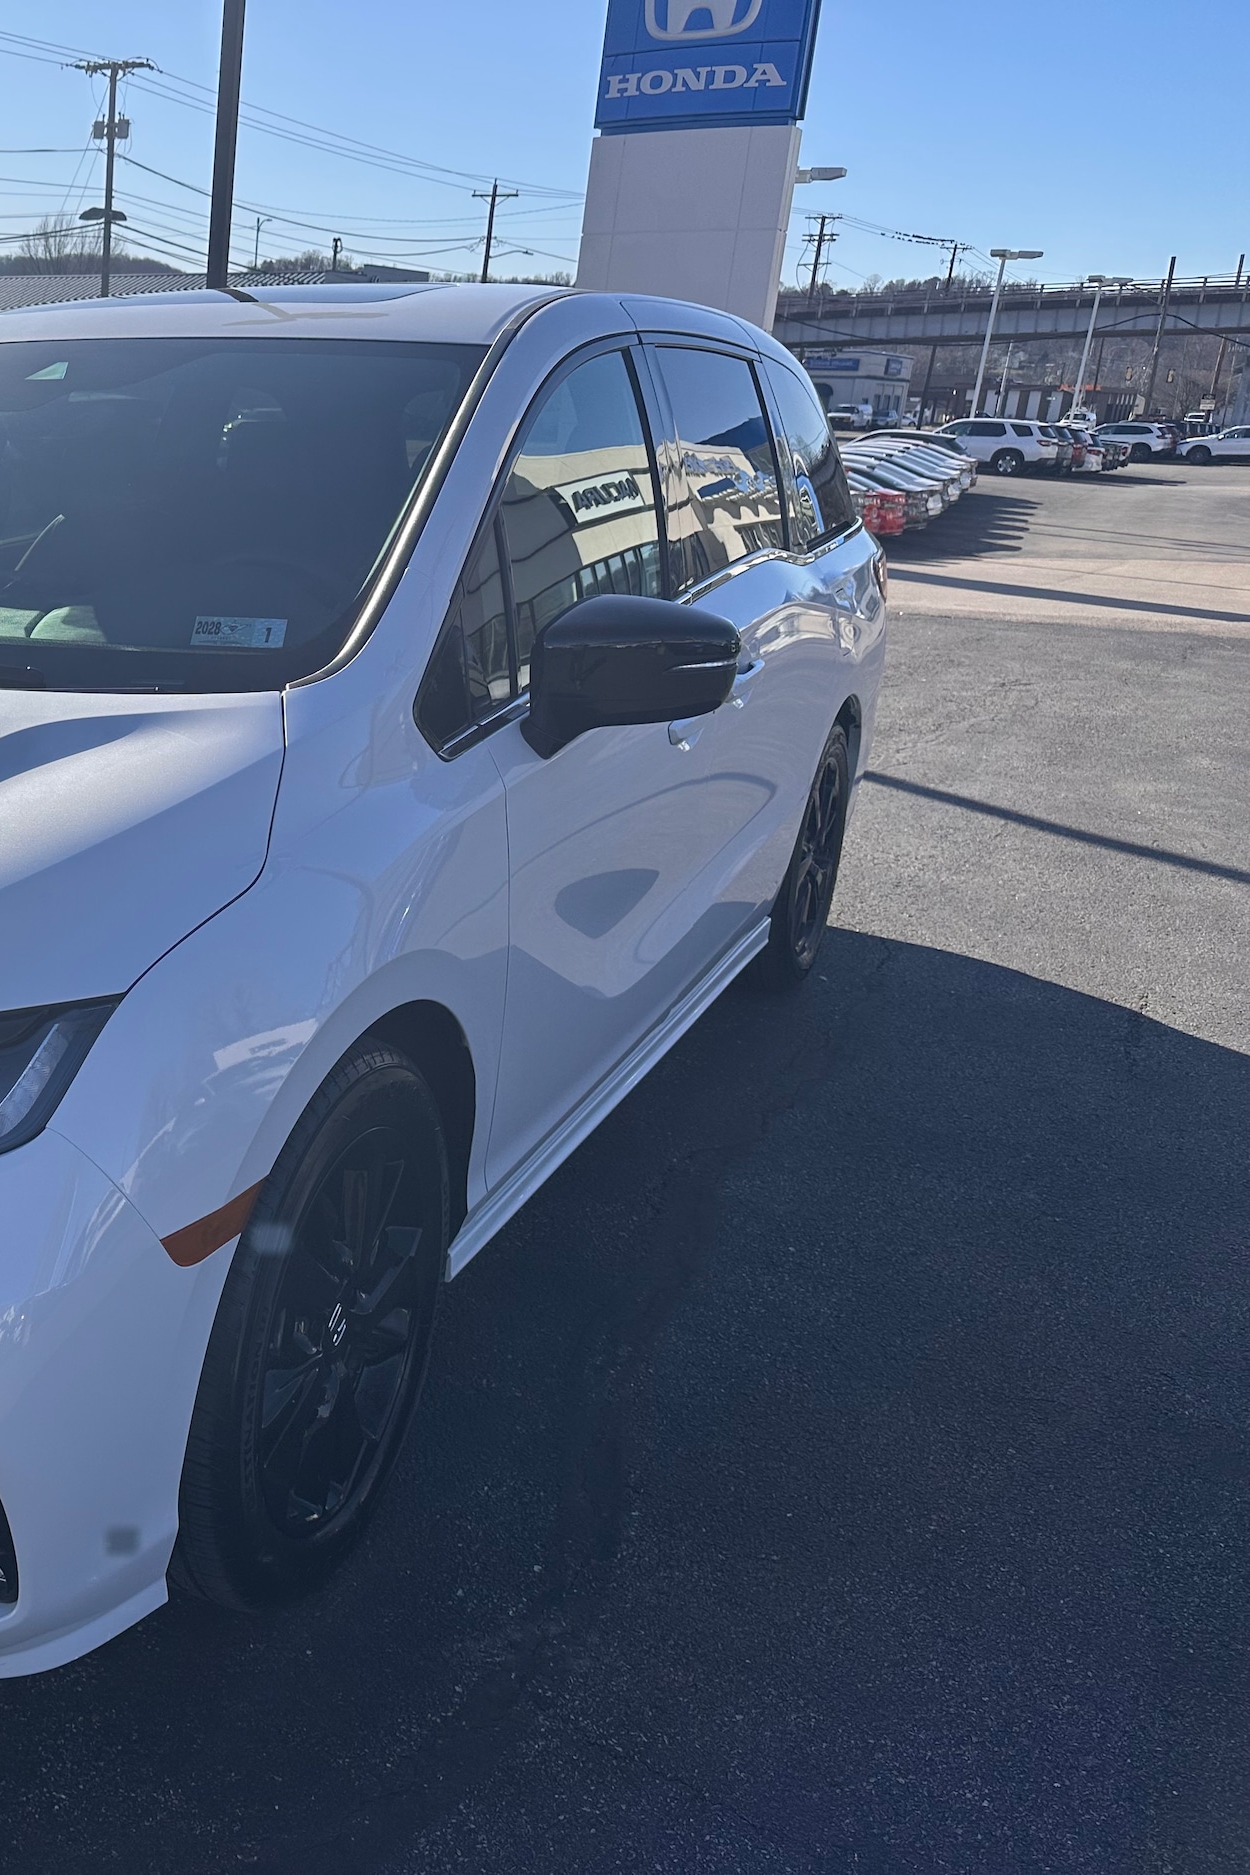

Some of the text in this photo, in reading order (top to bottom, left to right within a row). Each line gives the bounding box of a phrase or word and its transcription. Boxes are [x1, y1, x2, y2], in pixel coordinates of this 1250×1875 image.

[604, 62, 787, 99] HONDA
[195, 621, 272, 643] 2028 1
